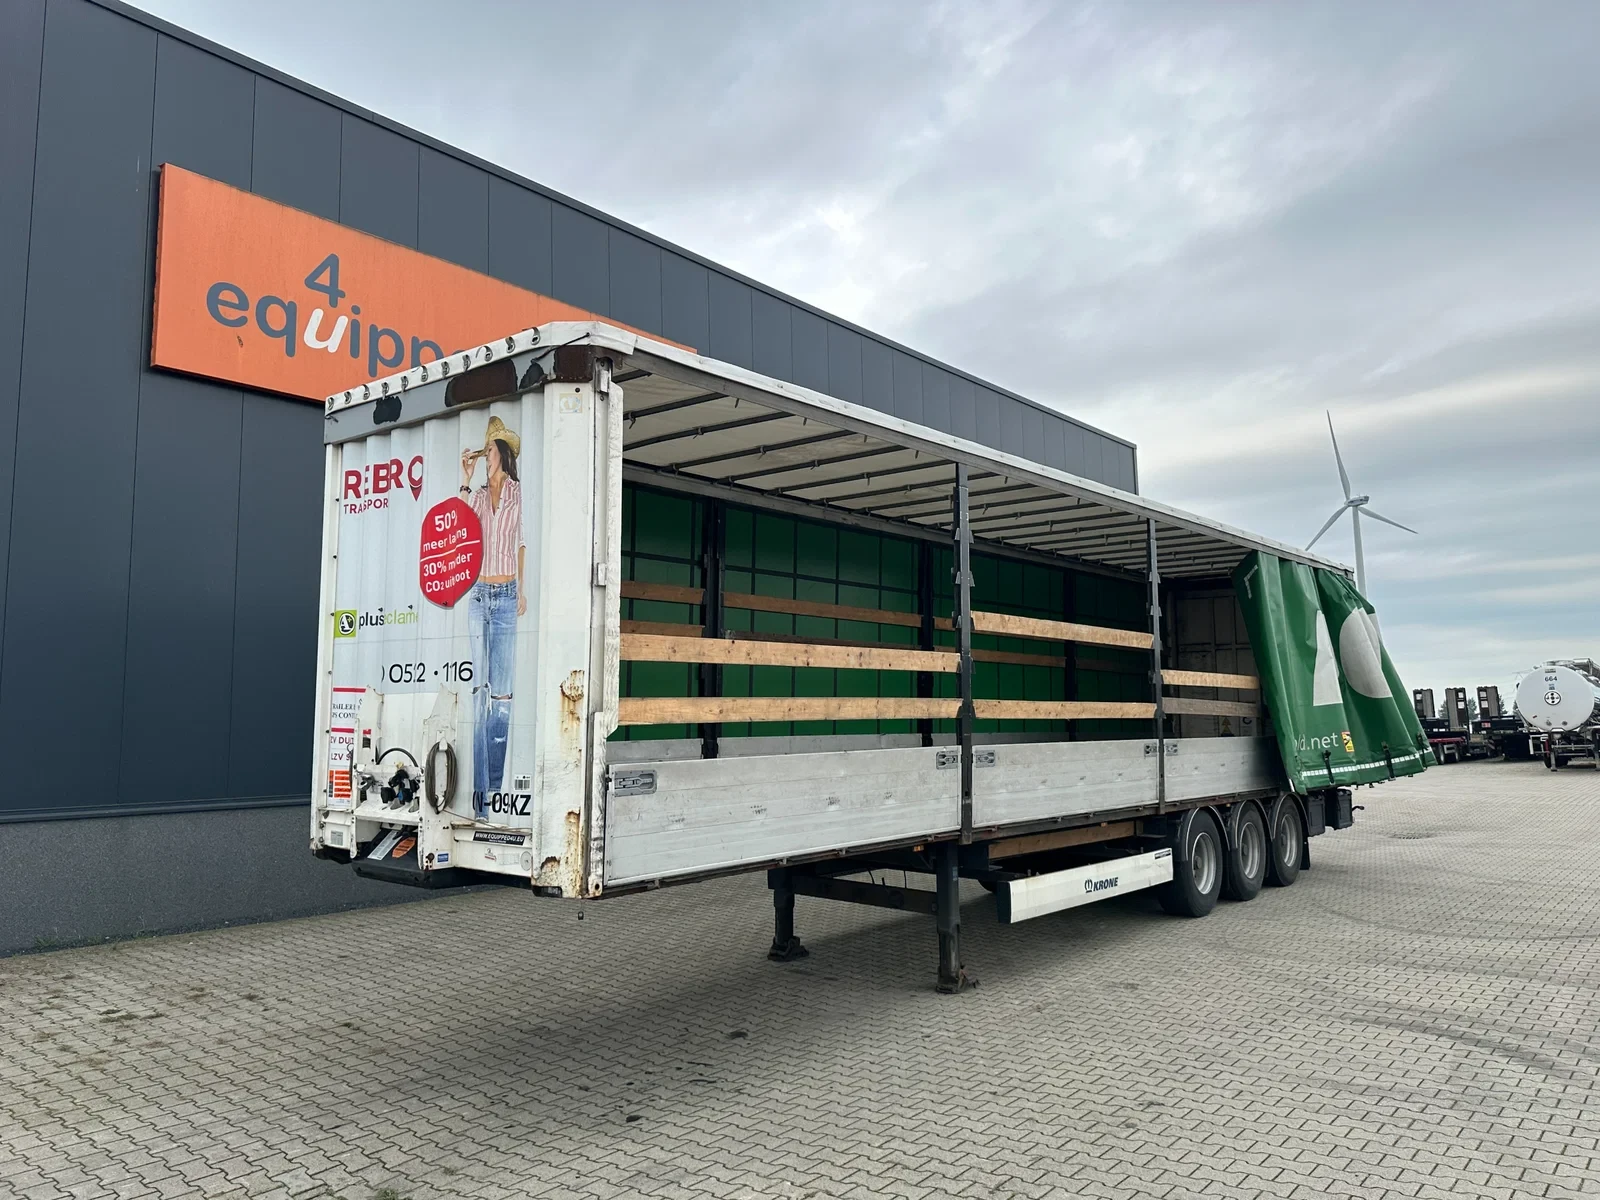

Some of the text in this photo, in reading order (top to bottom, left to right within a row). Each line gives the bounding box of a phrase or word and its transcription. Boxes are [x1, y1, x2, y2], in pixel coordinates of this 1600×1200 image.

[304, 253, 346, 308] 4
[206, 281, 466, 378] equipp
[423, 537, 448, 553] meer
[423, 560, 447, 577] 30%
[1093, 877, 1119, 892] KRONE
